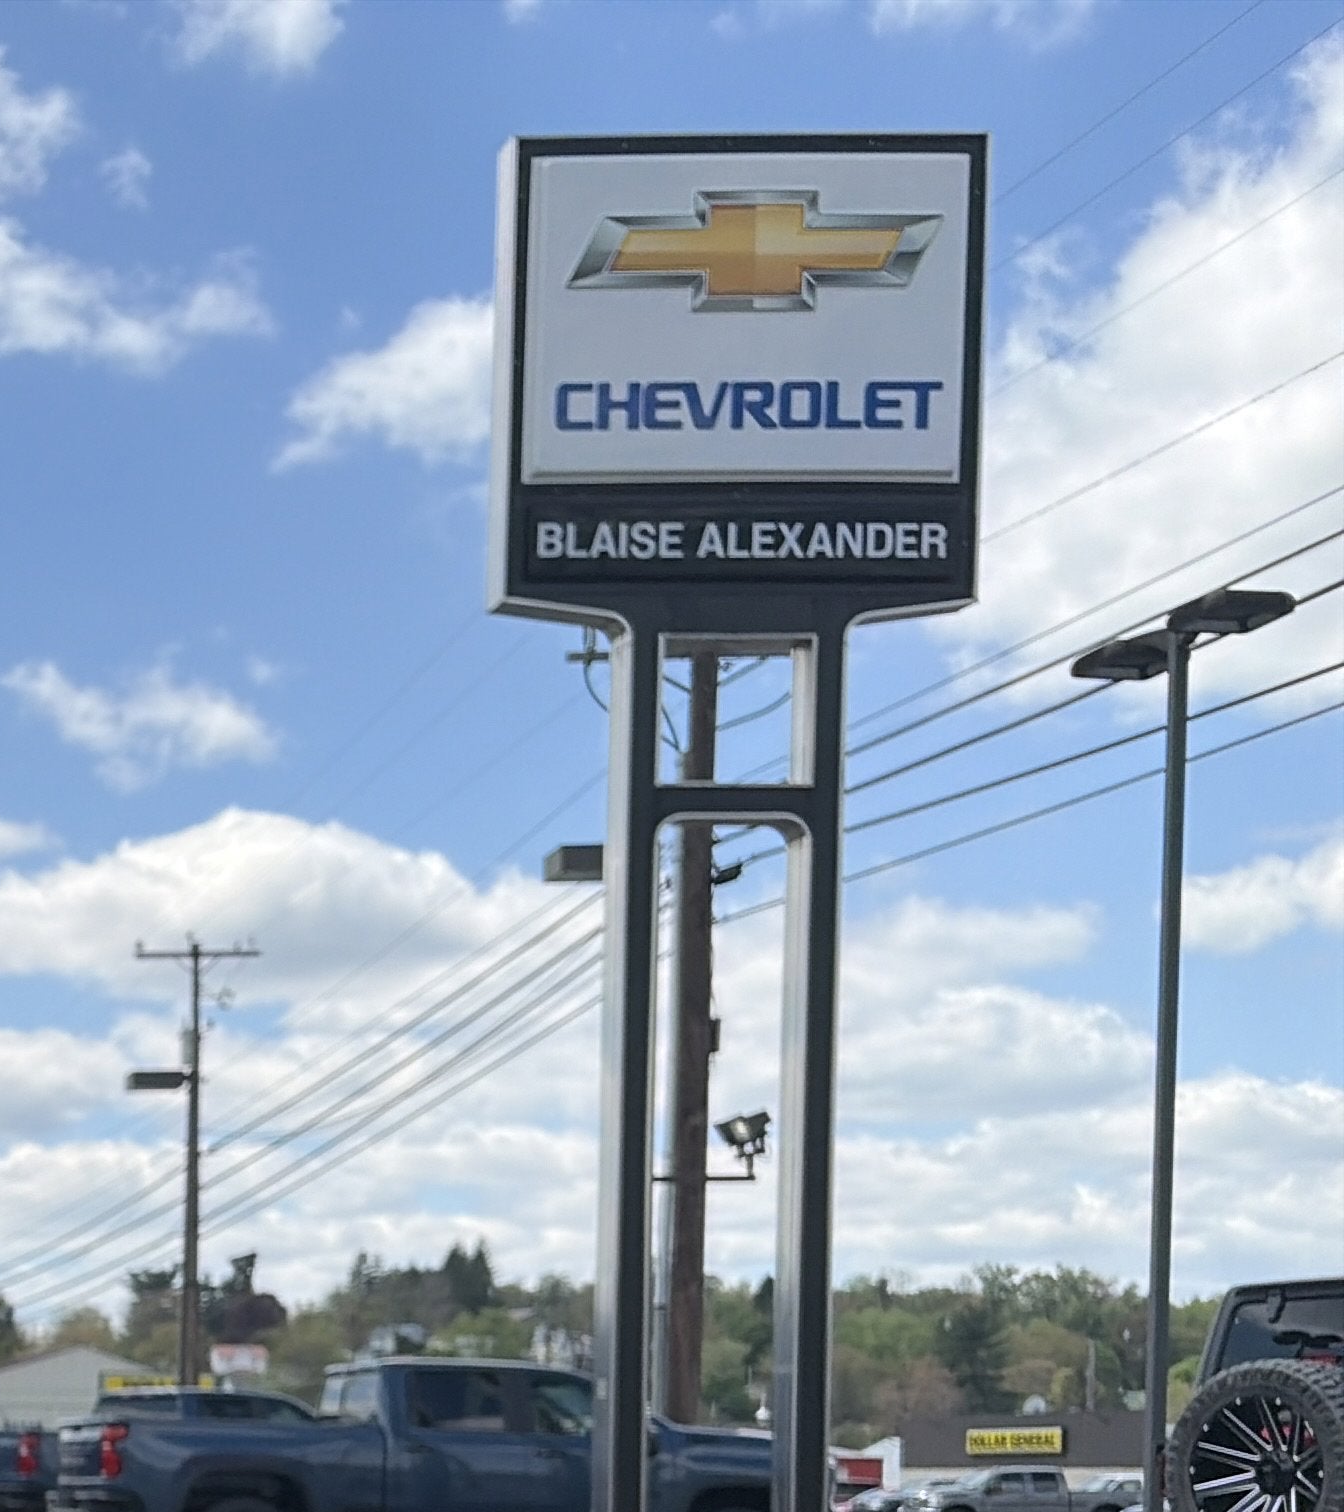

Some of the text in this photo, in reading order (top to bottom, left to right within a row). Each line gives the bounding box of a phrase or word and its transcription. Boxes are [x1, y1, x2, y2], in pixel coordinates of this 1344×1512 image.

[554, 380, 944, 431] CHEVROLET
[536, 521, 948, 559] BLAISE ALEXANDER
